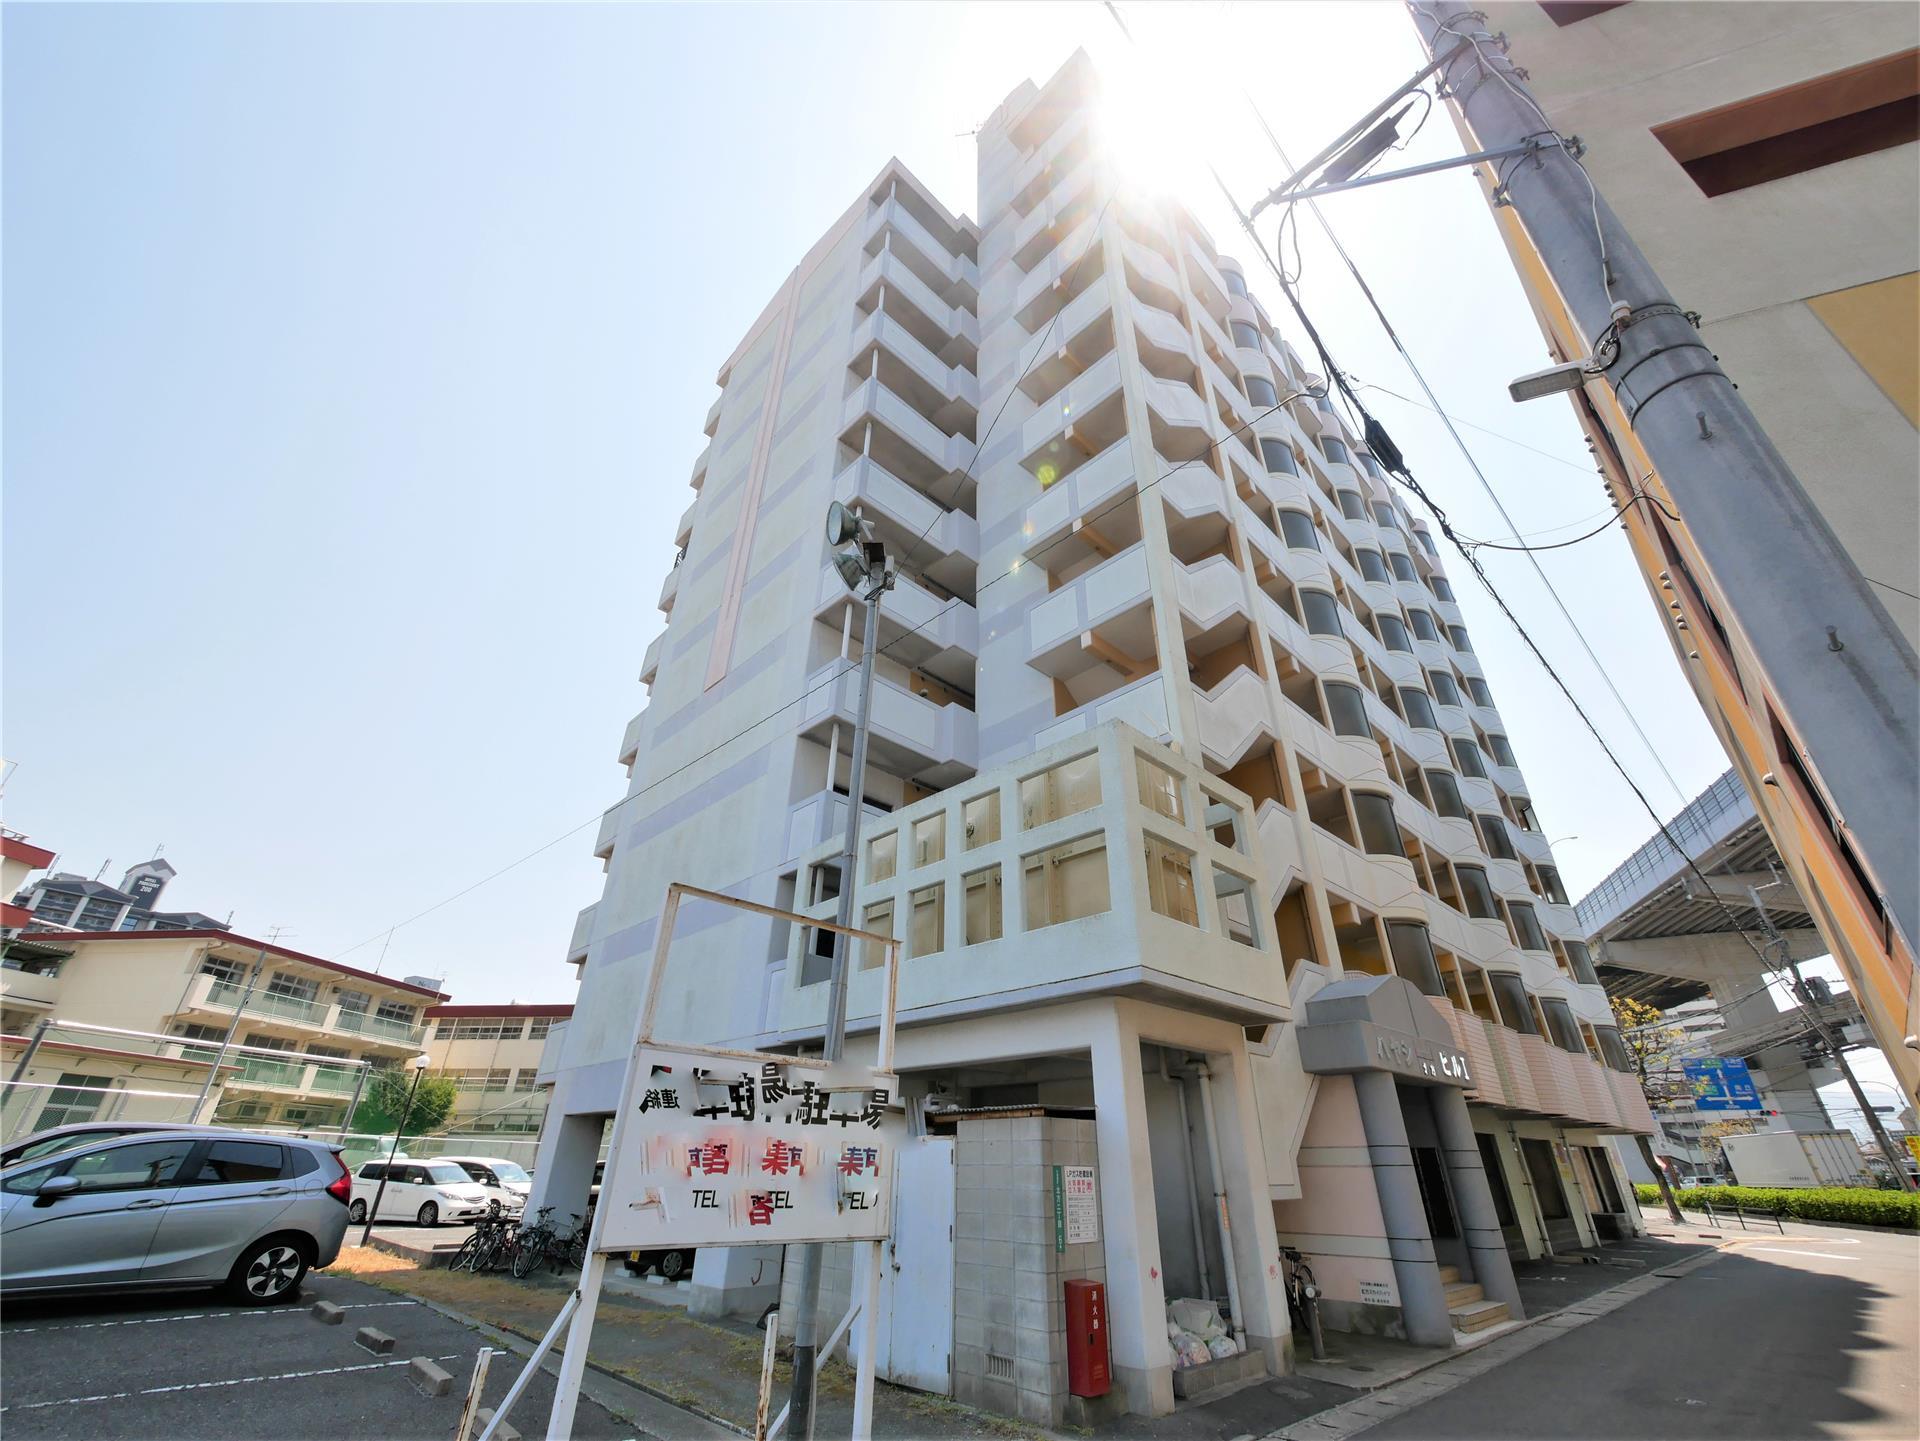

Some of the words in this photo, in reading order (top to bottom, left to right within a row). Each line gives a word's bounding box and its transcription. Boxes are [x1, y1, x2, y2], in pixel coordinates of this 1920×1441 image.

[692, 1190, 719, 1208] TEL
[846, 1191, 869, 1210] EL
[1091, 1290, 1099, 1330] 消火器
